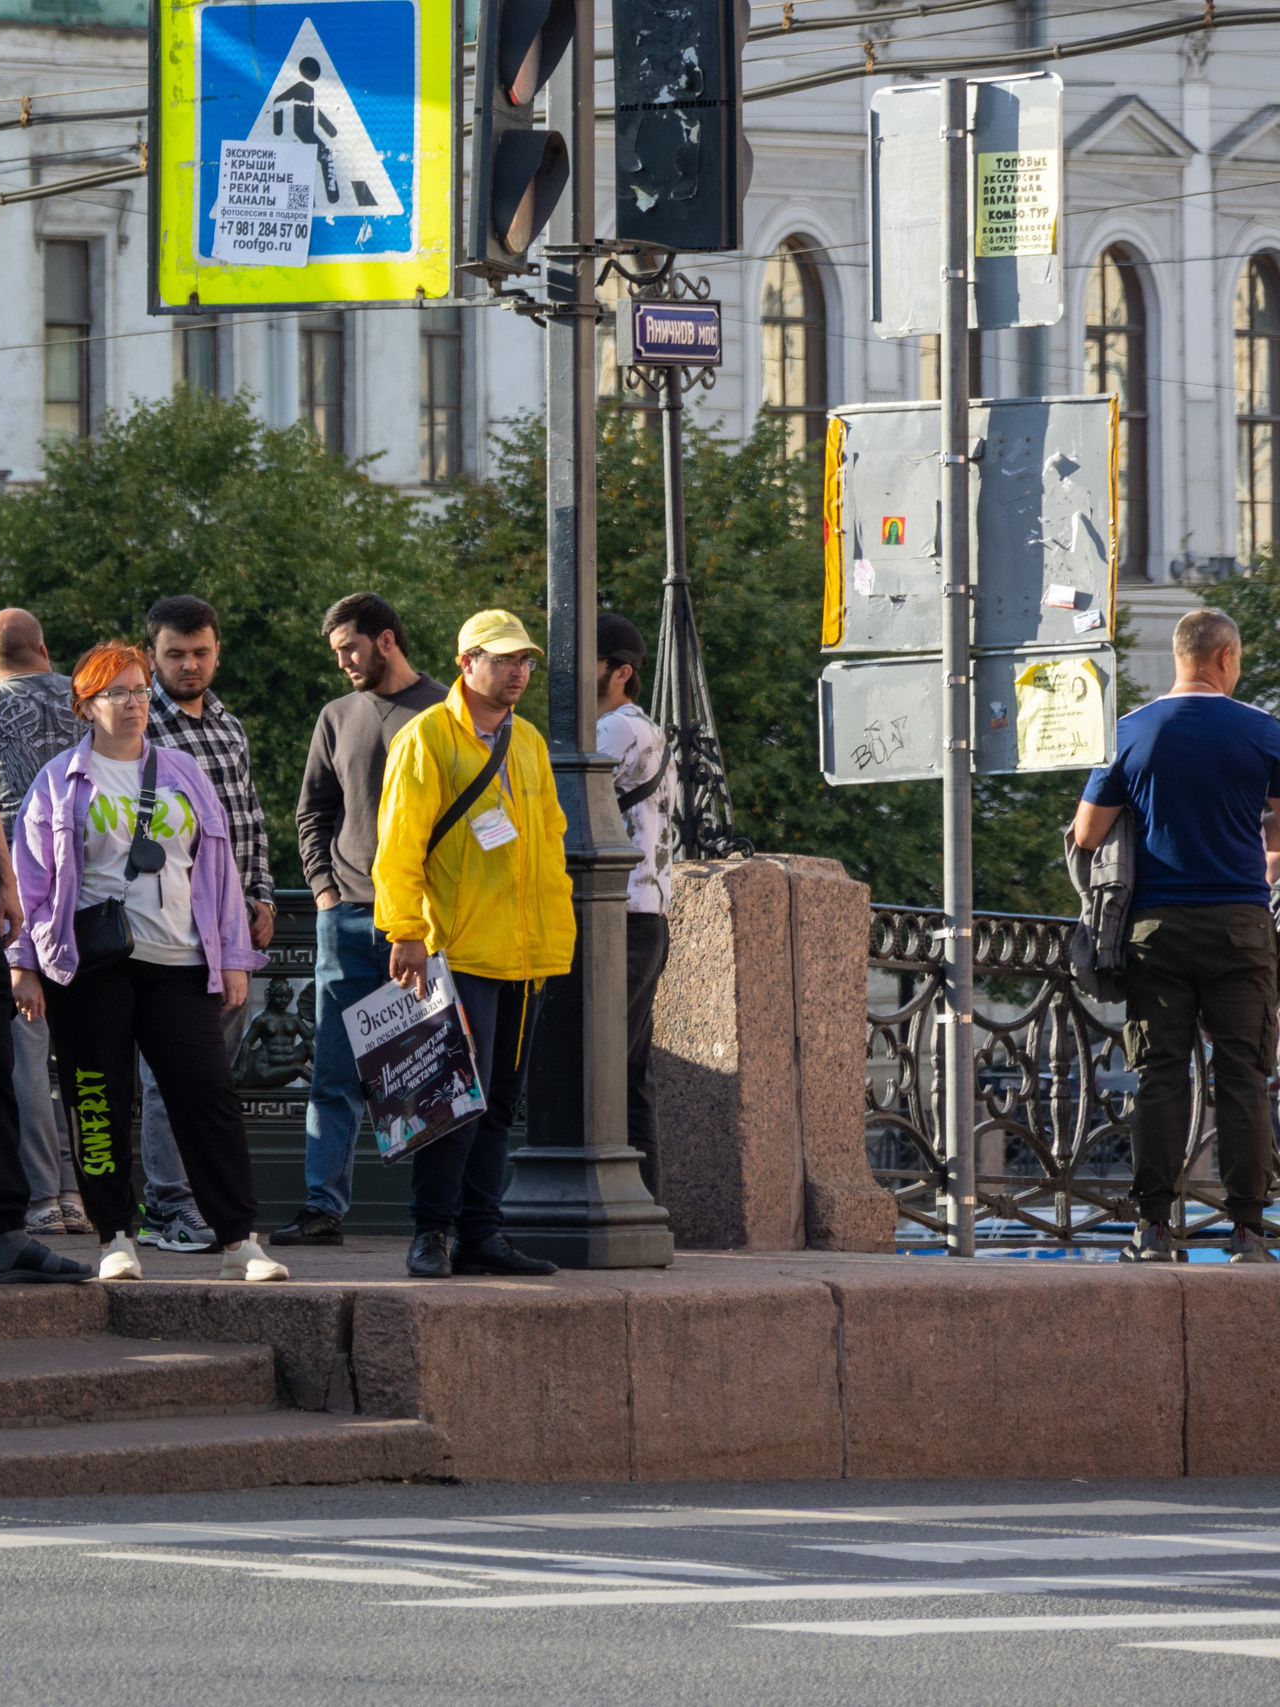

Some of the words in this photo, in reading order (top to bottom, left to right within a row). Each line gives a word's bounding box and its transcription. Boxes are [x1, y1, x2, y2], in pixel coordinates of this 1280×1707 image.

[225, 148, 277, 160] ЭКСКУРСИИ:
[230, 159, 275, 171] КРЫШИ
[995, 157, 1048, 169] ТОПОВЫЕ
[230, 171, 294, 184] ПАРАДНЫЕ
[229, 183, 258, 194] РЕКИ
[262, 184, 270, 194] И
[983, 186, 997, 195] ПО
[228, 194, 276, 206] КАНАЛЫ
[220, 207, 267, 218] фотосессия
[275, 212, 308, 221] подарок
[219, 220, 234, 235] +7
[235, 221, 254, 236] 981
[258, 222, 277, 237] 284
[280, 223, 293, 238] 57
[295, 224, 308, 239] 00
[233, 238, 292, 253] roofgo.ru
[376, 1024, 401, 1048] рекам
[409, 998, 444, 1025] каналам
[414, 1026, 448, 1060] прогулки
[407, 1062, 438, 1090] мостами
[75, 1067, 116, 1175] SGWERXT
